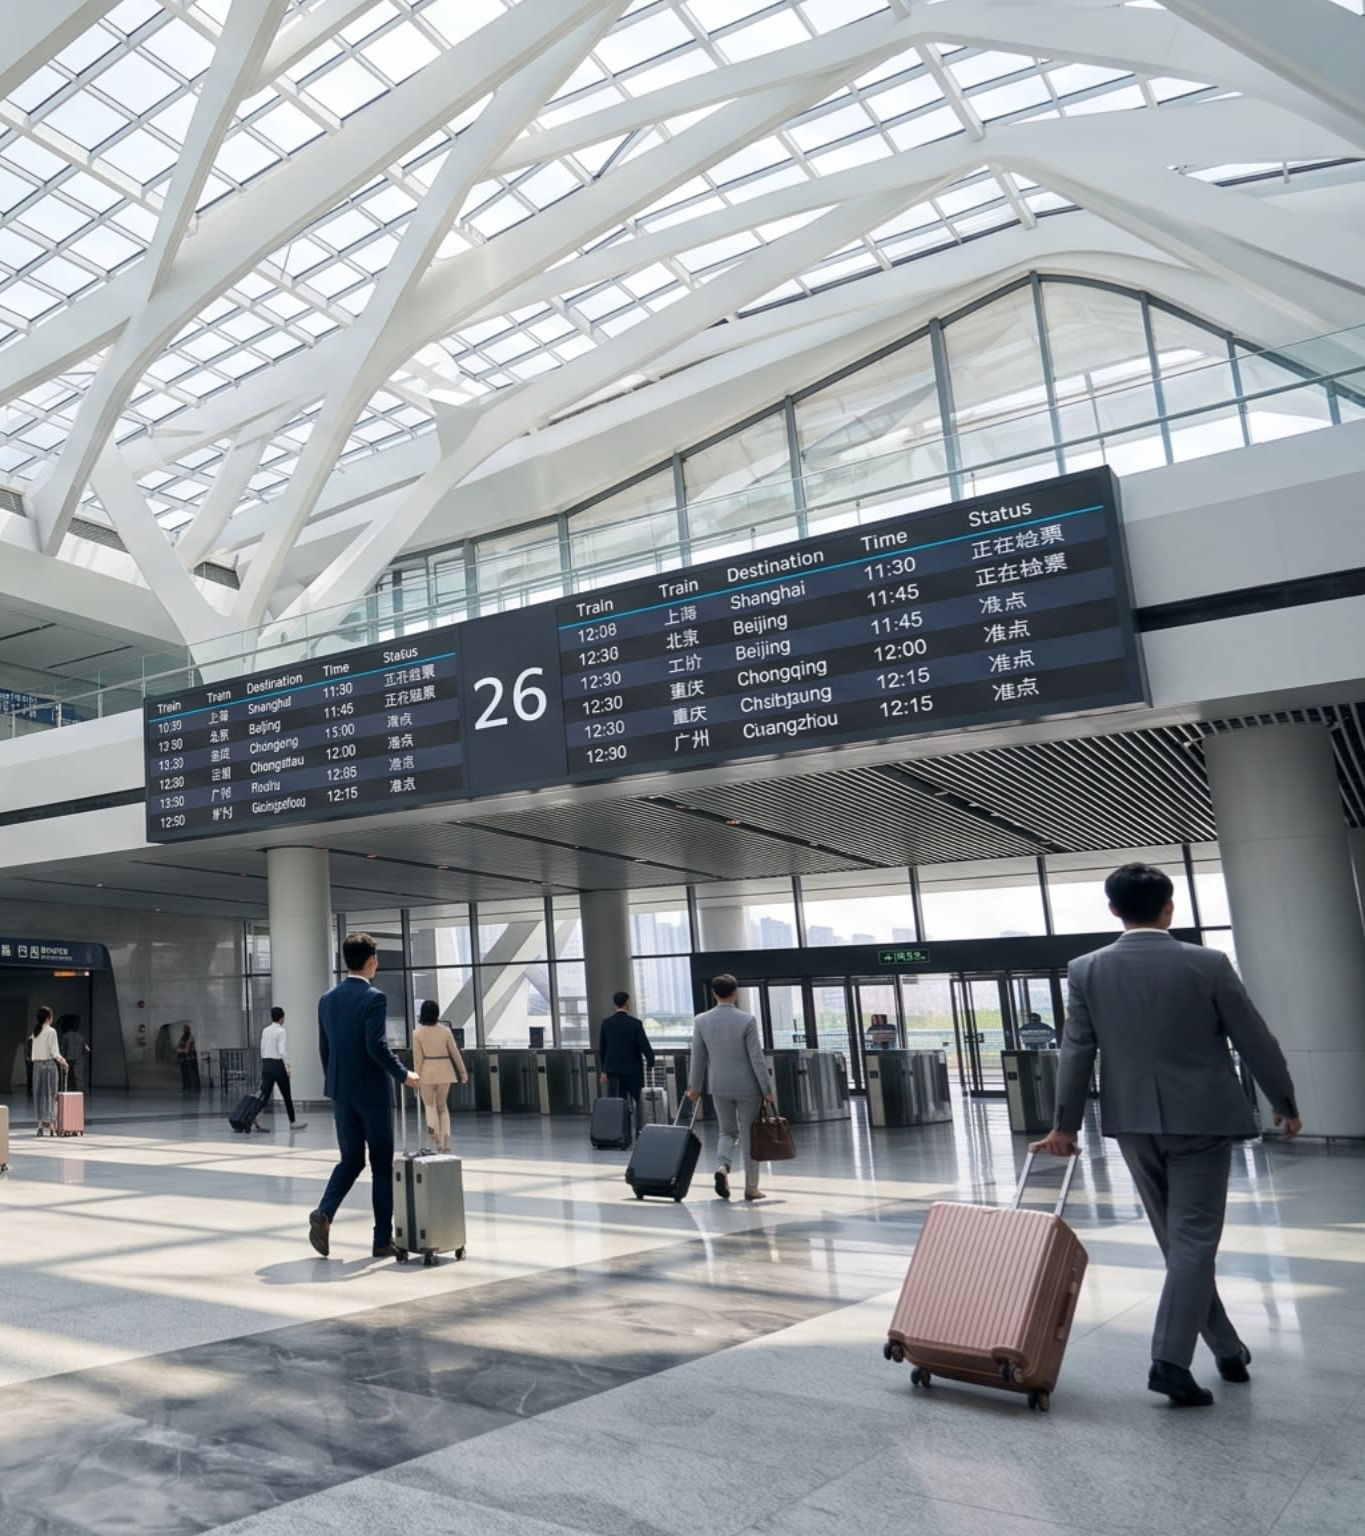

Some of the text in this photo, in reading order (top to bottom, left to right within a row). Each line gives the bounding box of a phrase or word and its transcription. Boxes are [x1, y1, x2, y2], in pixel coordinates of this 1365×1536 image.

[576, 502, 1033, 617] Train Train Destination Time Status
[730, 580, 806, 610] Shanghai
[864, 556, 916, 582] 11:30
[733, 614, 788, 636] Beijing
[867, 583, 920, 608] 11:45
[322, 662, 350, 677] Time
[580, 670, 622, 691] 12:30
[735, 639, 791, 661] Beijing
[870, 611, 924, 636] 11:45
[582, 695, 623, 715] 12:30
[737, 660, 827, 687] Chongqing
[873, 638, 927, 663] 12:00
[323, 682, 354, 698] 11:30
[473, 667, 547, 730] 26
[585, 720, 625, 739] 12:30
[876, 667, 931, 690] 12:15
[879, 695, 934, 718] 12:15
[327, 786, 358, 802] 12:15
